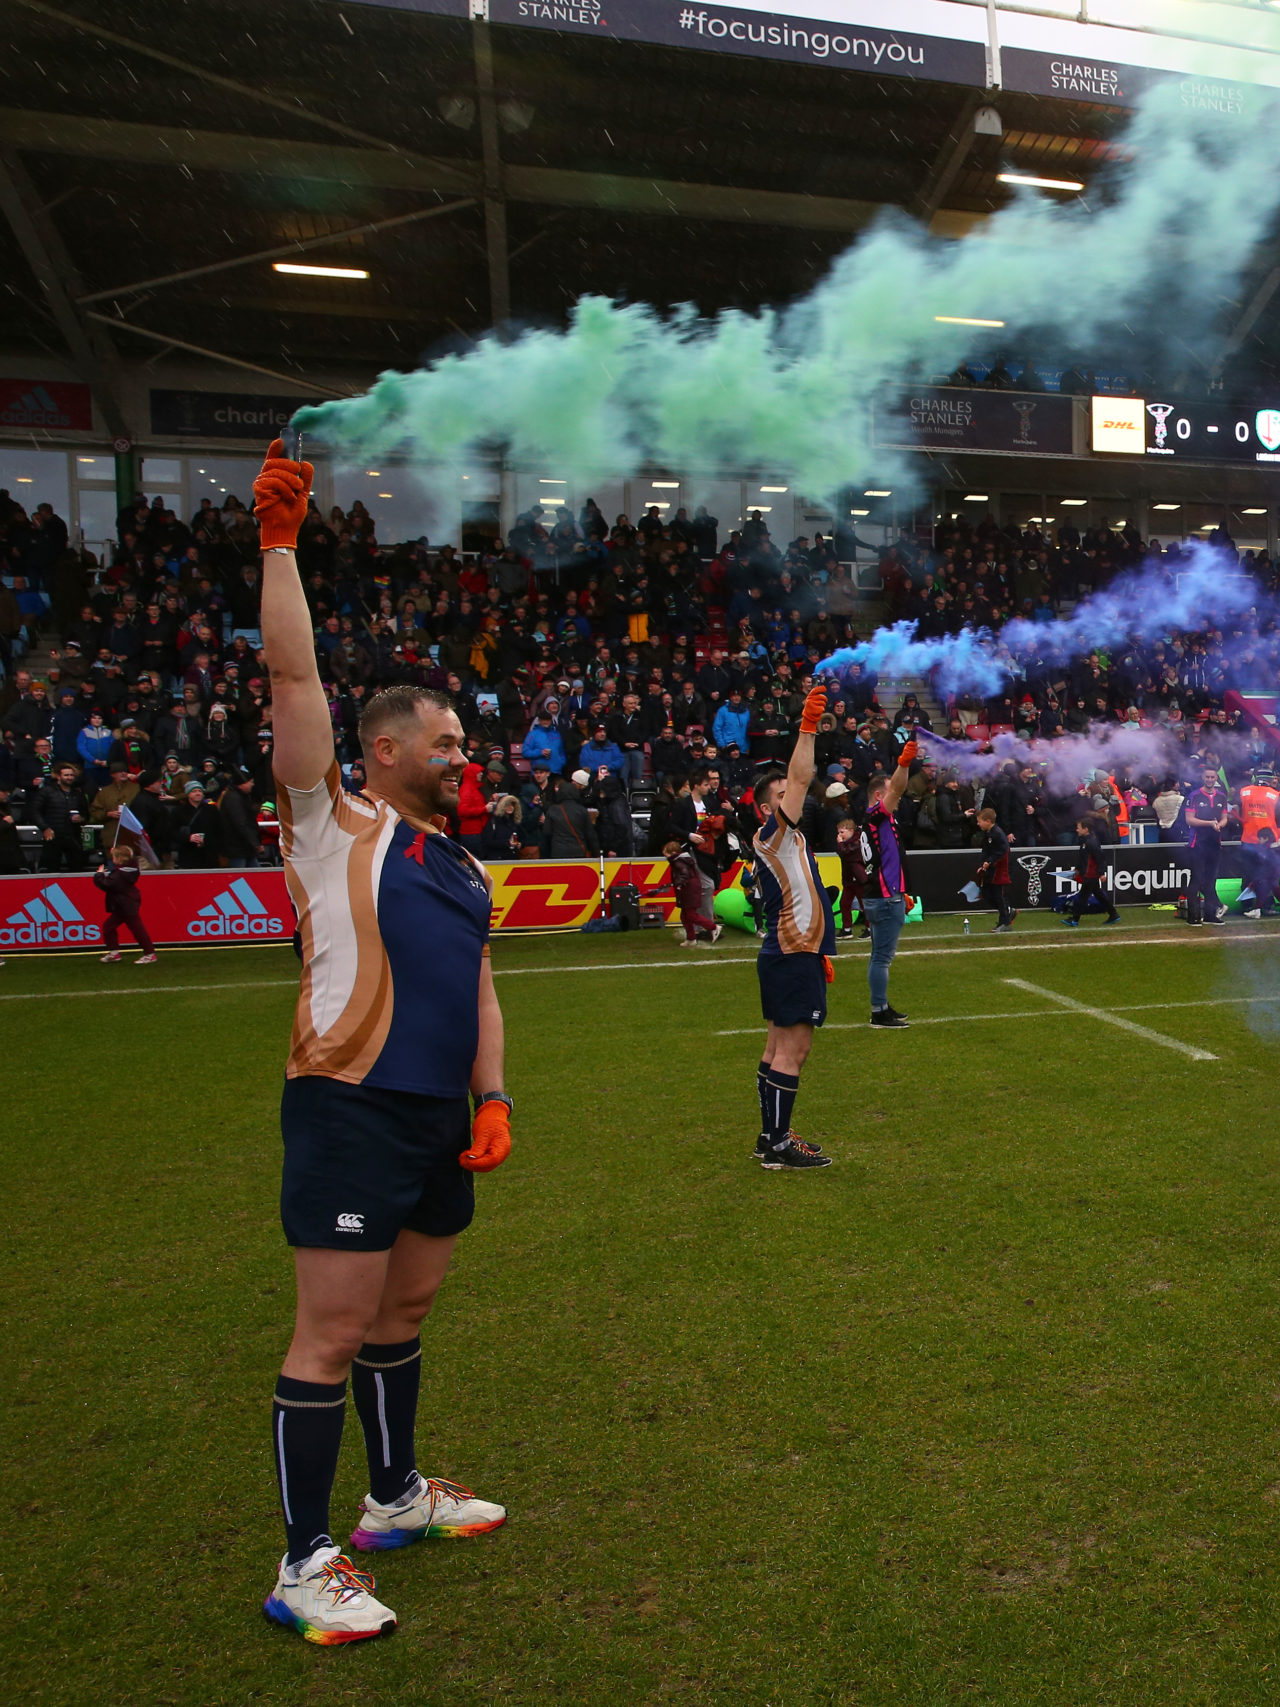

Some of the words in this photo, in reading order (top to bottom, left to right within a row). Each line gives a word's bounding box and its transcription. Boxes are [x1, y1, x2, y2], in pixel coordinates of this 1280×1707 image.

[518, 1, 601, 25] STANLEY
[678, 8, 925, 64] #focusingonyou
[1050, 61, 1118, 83] CHARLES
[1051, 75, 1118, 97] STANLEY
[1180, 81, 1244, 101] CHARLES
[1181, 94, 1244, 114] STANLEY
[0, 404, 70, 427] adidas
[910, 398, 972, 413] CHARLES
[911, 411, 972, 426] STANLEY
[1102, 420, 1135, 430] DHL
[1176, 418, 1191, 440] 0
[1235, 421, 1250, 442] 0
[1056, 862, 1192, 896] Hlequin
[0, 921, 101, 945] adidas
[187, 914, 283, 937] adidas
